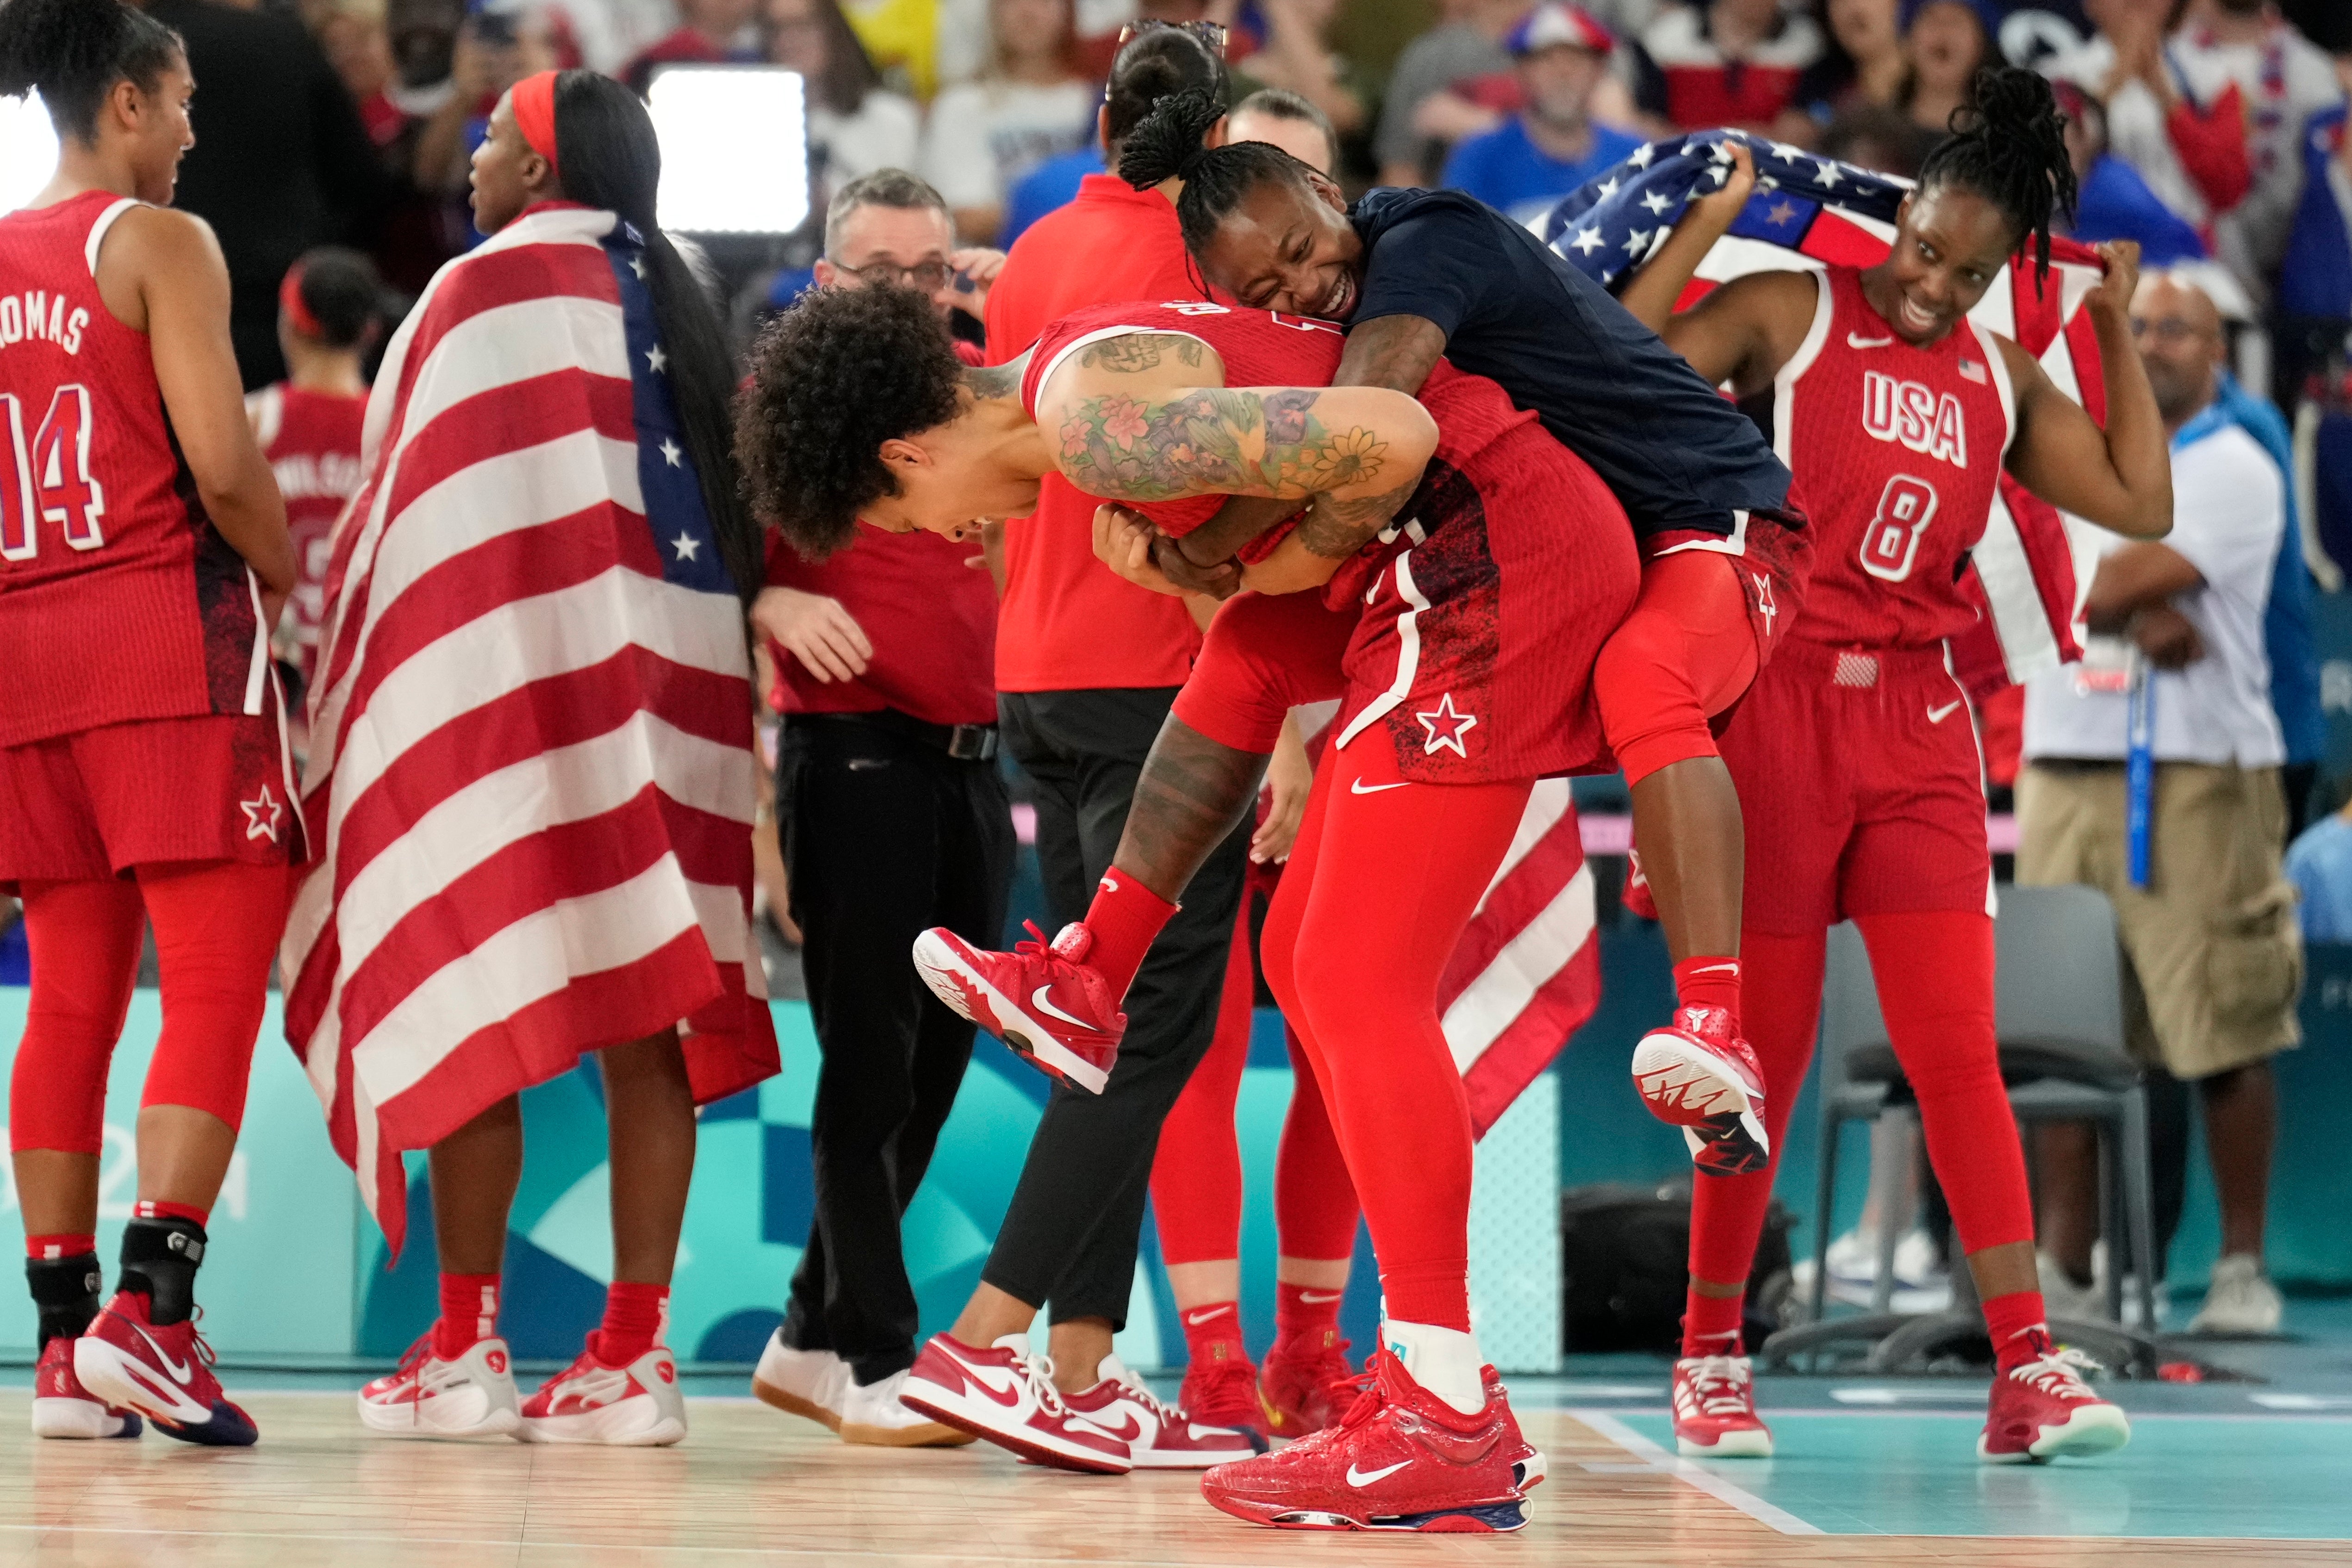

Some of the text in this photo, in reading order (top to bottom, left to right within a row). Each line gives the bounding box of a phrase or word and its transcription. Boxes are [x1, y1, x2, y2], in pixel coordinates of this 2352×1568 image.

[0, 290, 90, 356] OMAS
[1863, 370, 1967, 468] USA
[0, 384, 105, 561] 14
[1860, 473, 1938, 582] 8
